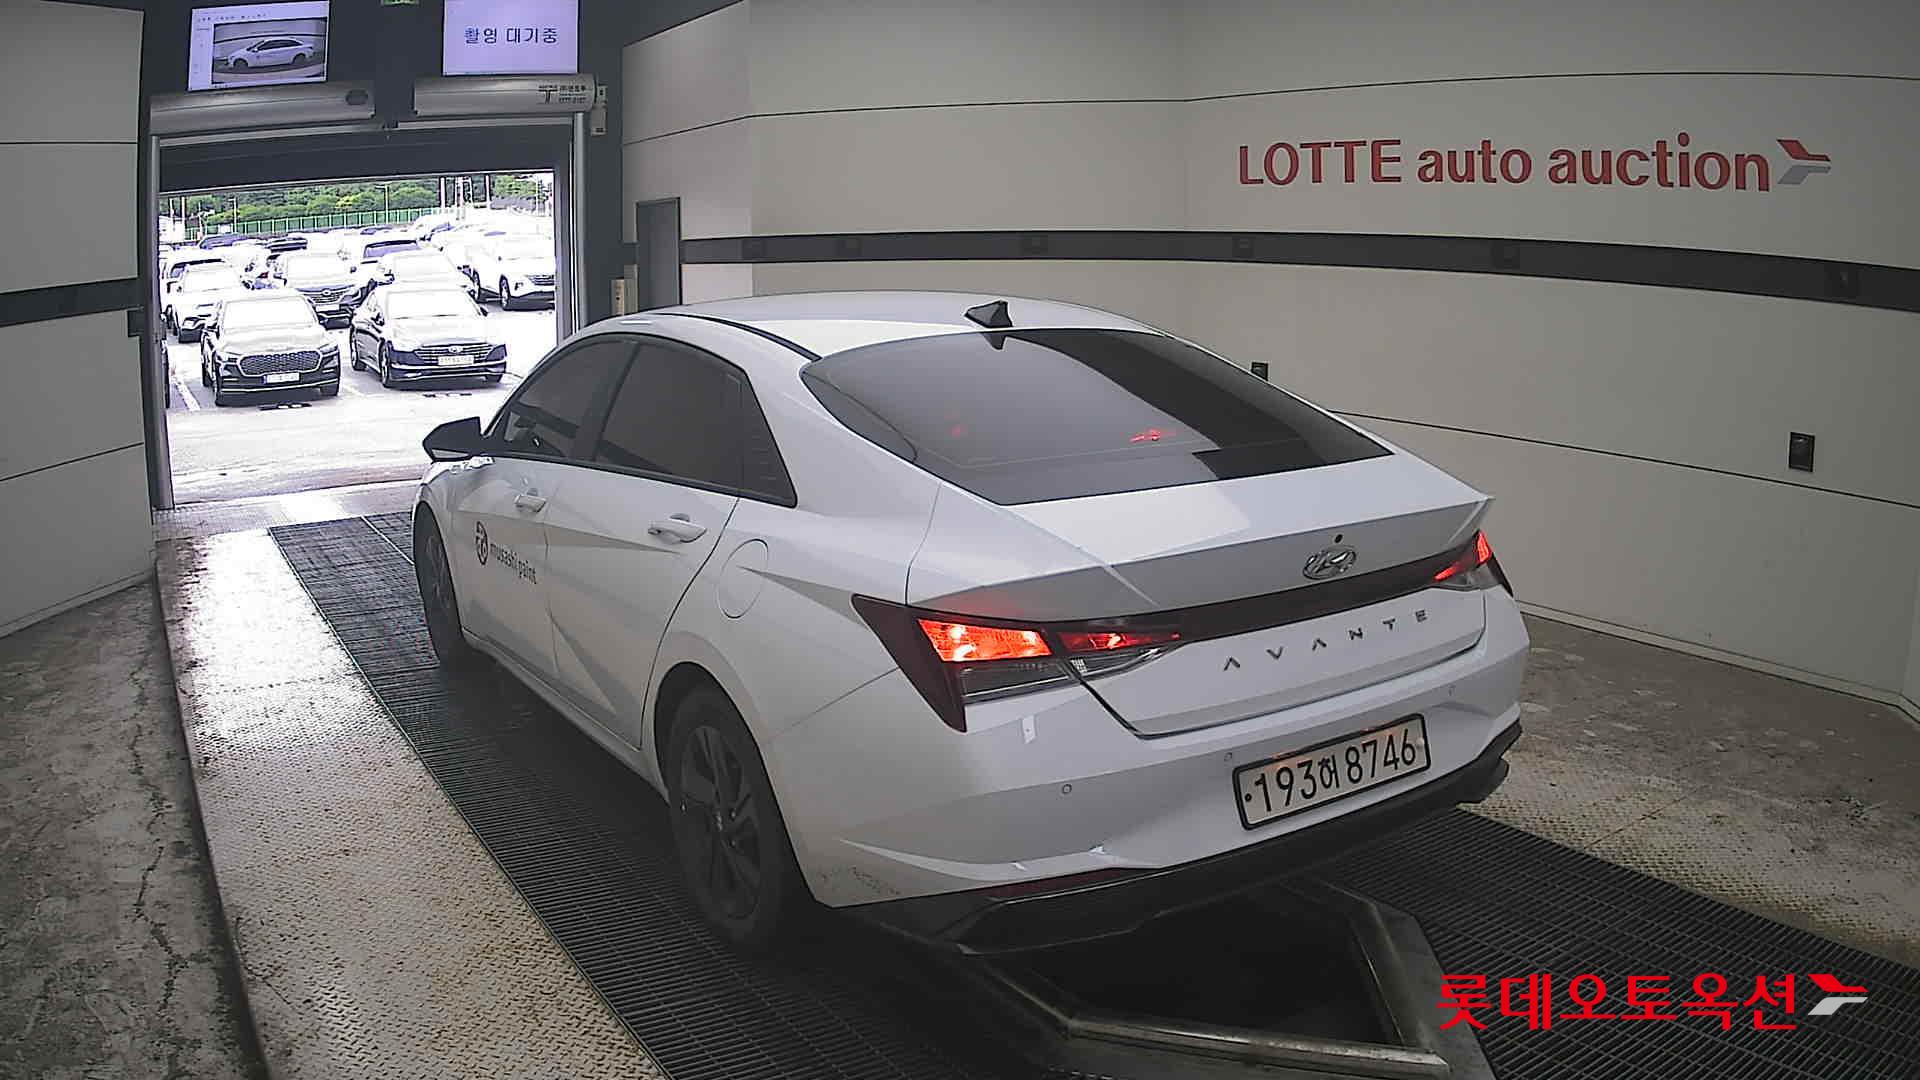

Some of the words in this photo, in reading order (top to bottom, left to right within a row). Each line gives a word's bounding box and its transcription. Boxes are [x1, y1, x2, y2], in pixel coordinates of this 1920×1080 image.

[505, 27, 558, 44] 대기중
[1239, 139, 1402, 186] LOTTE
[1417, 139, 1532, 184] auto
[1549, 131, 1771, 192] auction
[1223, 609, 1428, 672] AVANTE
